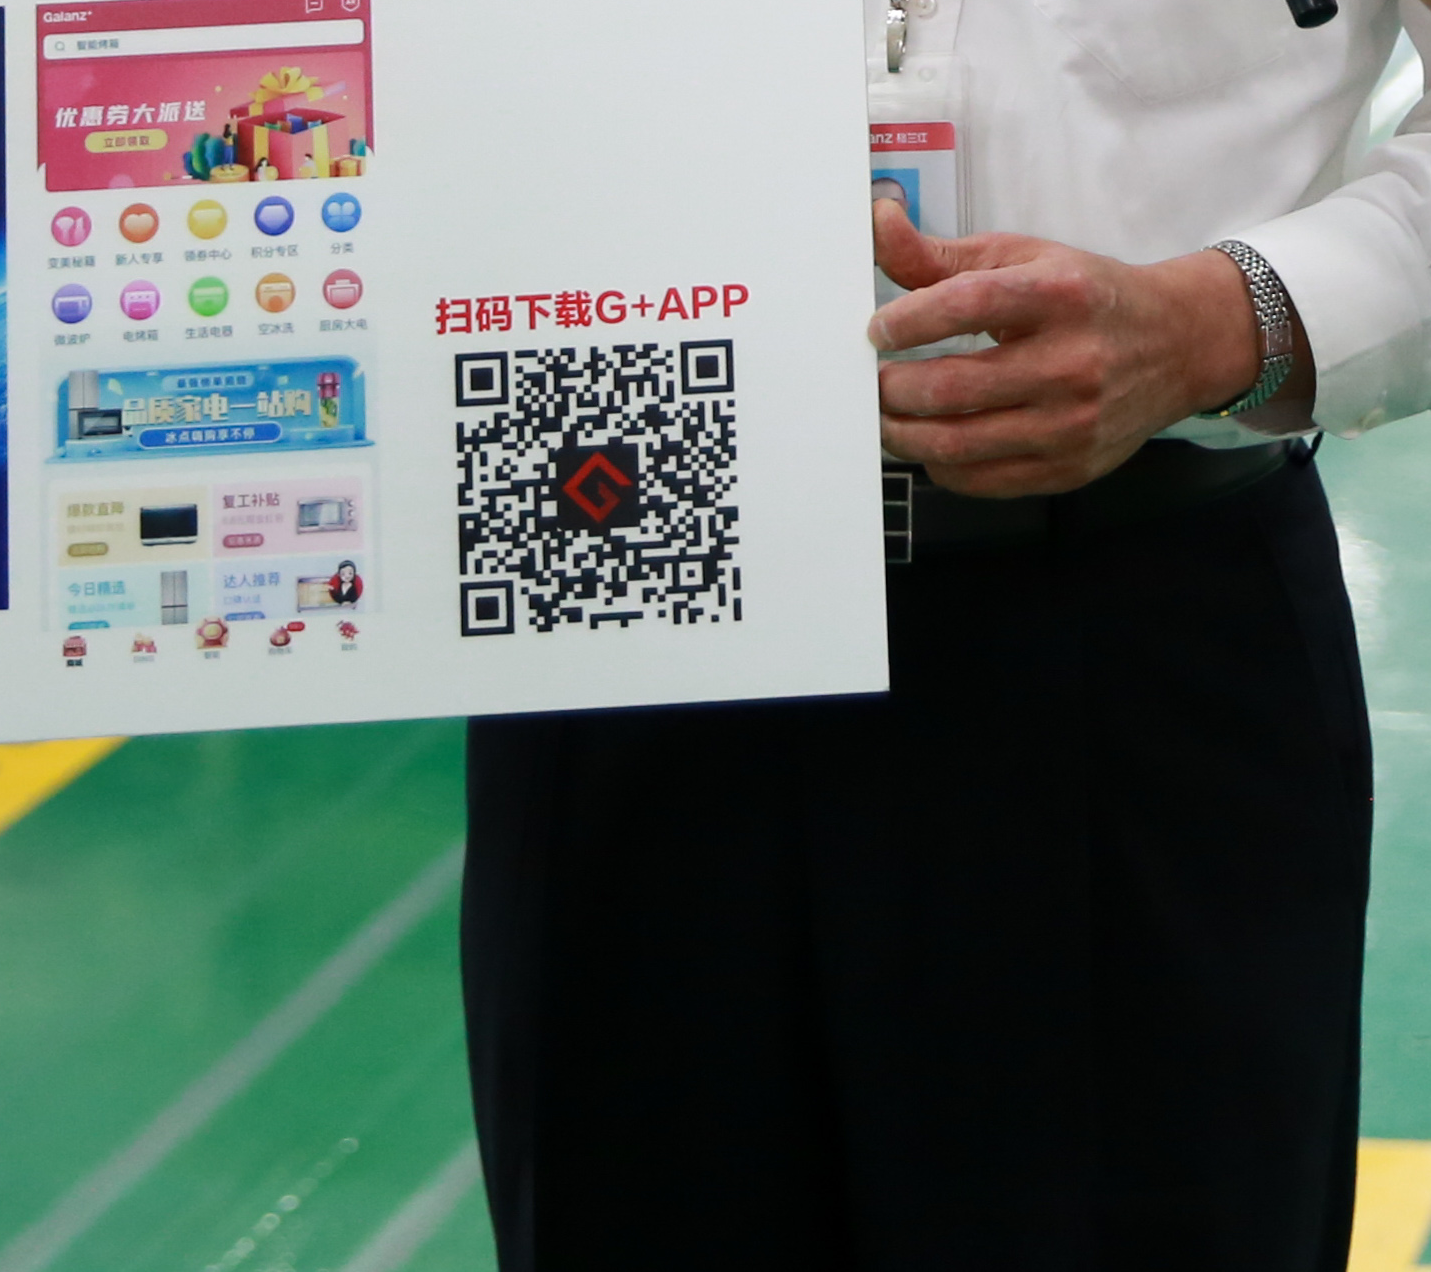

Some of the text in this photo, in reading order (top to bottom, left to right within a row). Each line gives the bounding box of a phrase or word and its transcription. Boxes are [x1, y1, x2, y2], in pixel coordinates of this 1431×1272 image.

[55, 100, 207, 129] 优惠券大派送
[251, 244, 299, 258] 积分专区
[330, 242, 355, 254] 分类
[115, 252, 164, 266] 新人专享
[435, 283, 750, 335] 扫码下载G+APP
[185, 325, 233, 340] 生活电器
[319, 318, 368, 332] 厨房大电
[123, 329, 159, 342] 电烤箱
[121, 390, 312, 425] 品质家电一站购
[223, 492, 280, 509] 复工补贴
[223, 571, 281, 589] 达人推荐
[68, 580, 126, 597] 今日精选
